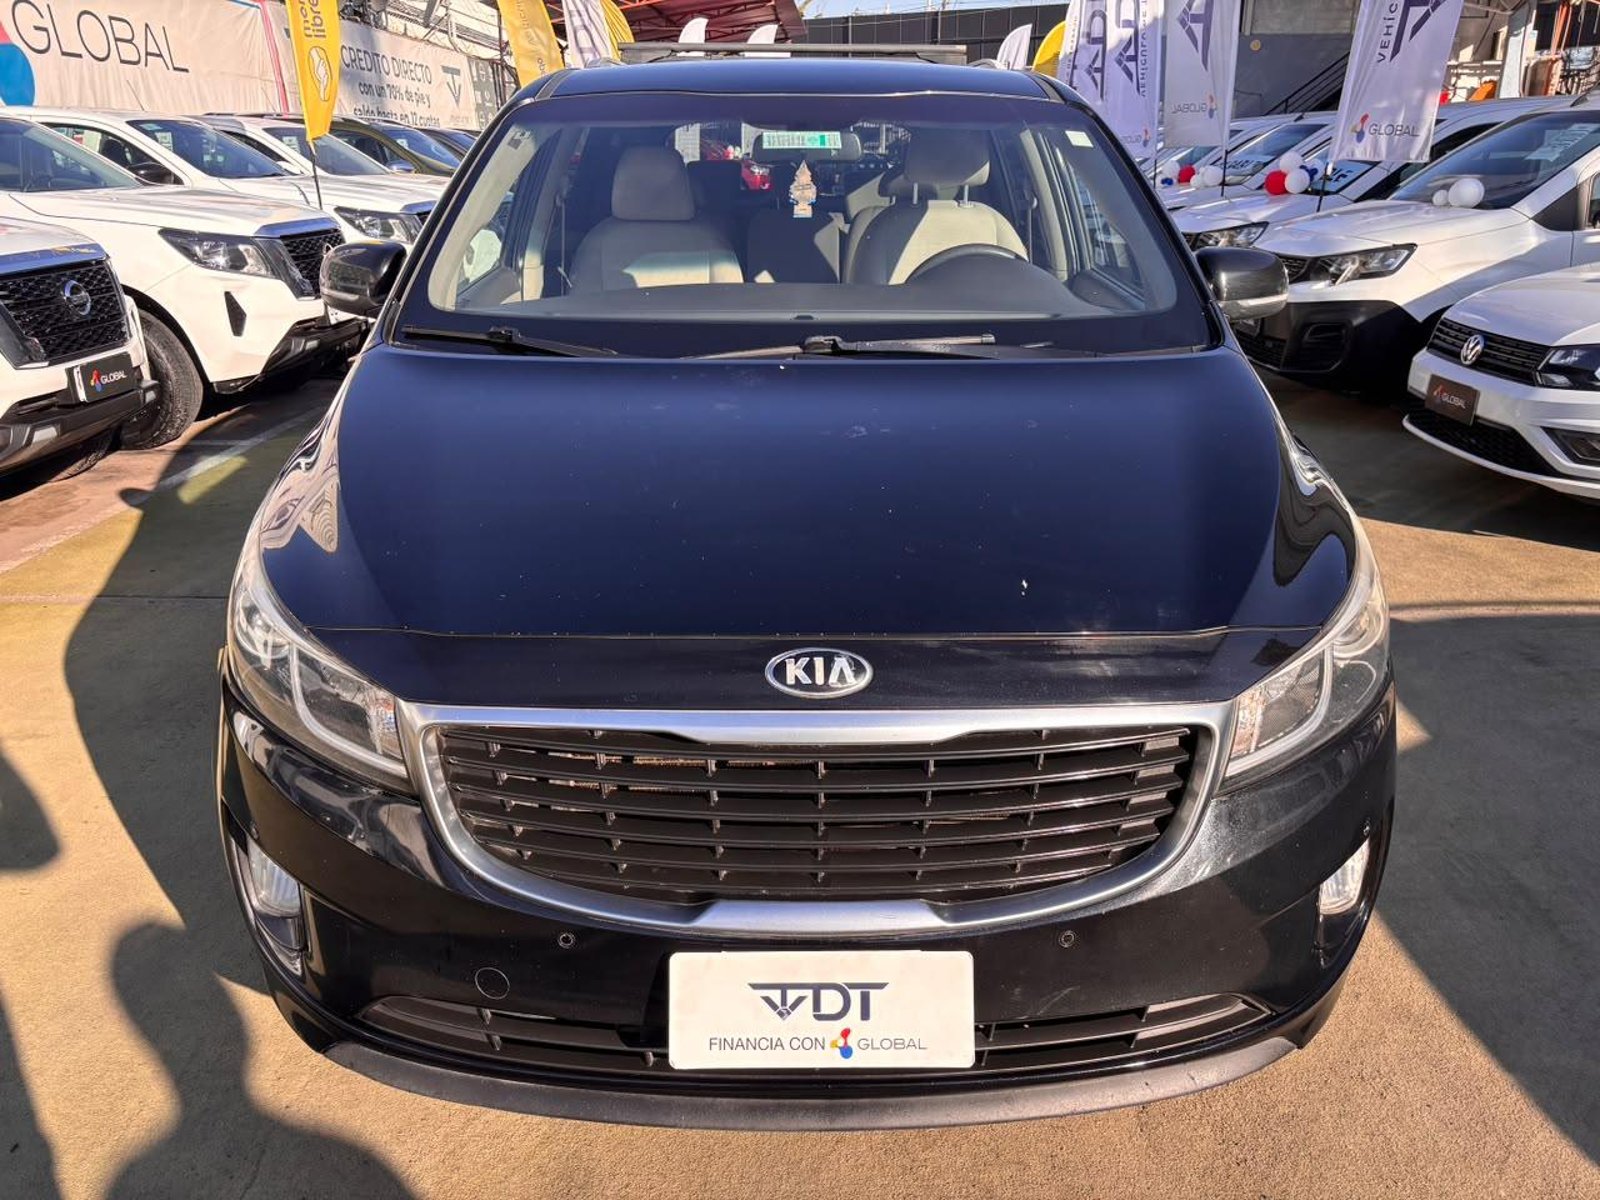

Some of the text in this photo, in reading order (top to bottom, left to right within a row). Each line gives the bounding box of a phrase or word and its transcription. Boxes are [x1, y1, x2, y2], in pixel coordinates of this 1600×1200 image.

[11, 0, 189, 73] GLOBAL
[391, 57, 432, 85] DIRECTO
[358, 82, 375, 97] con
[376, 84, 387, 98] un
[387, 83, 404, 101] 70%
[405, 86, 414, 102] de
[414, 87, 425, 107] pie
[1368, 123, 1420, 137] GLOBAL
[100, 370, 127, 385] GLOBAL
[785, 655, 857, 687] KIA
[709, 1036, 928, 1051] FINANCIA CON GLOBAL
